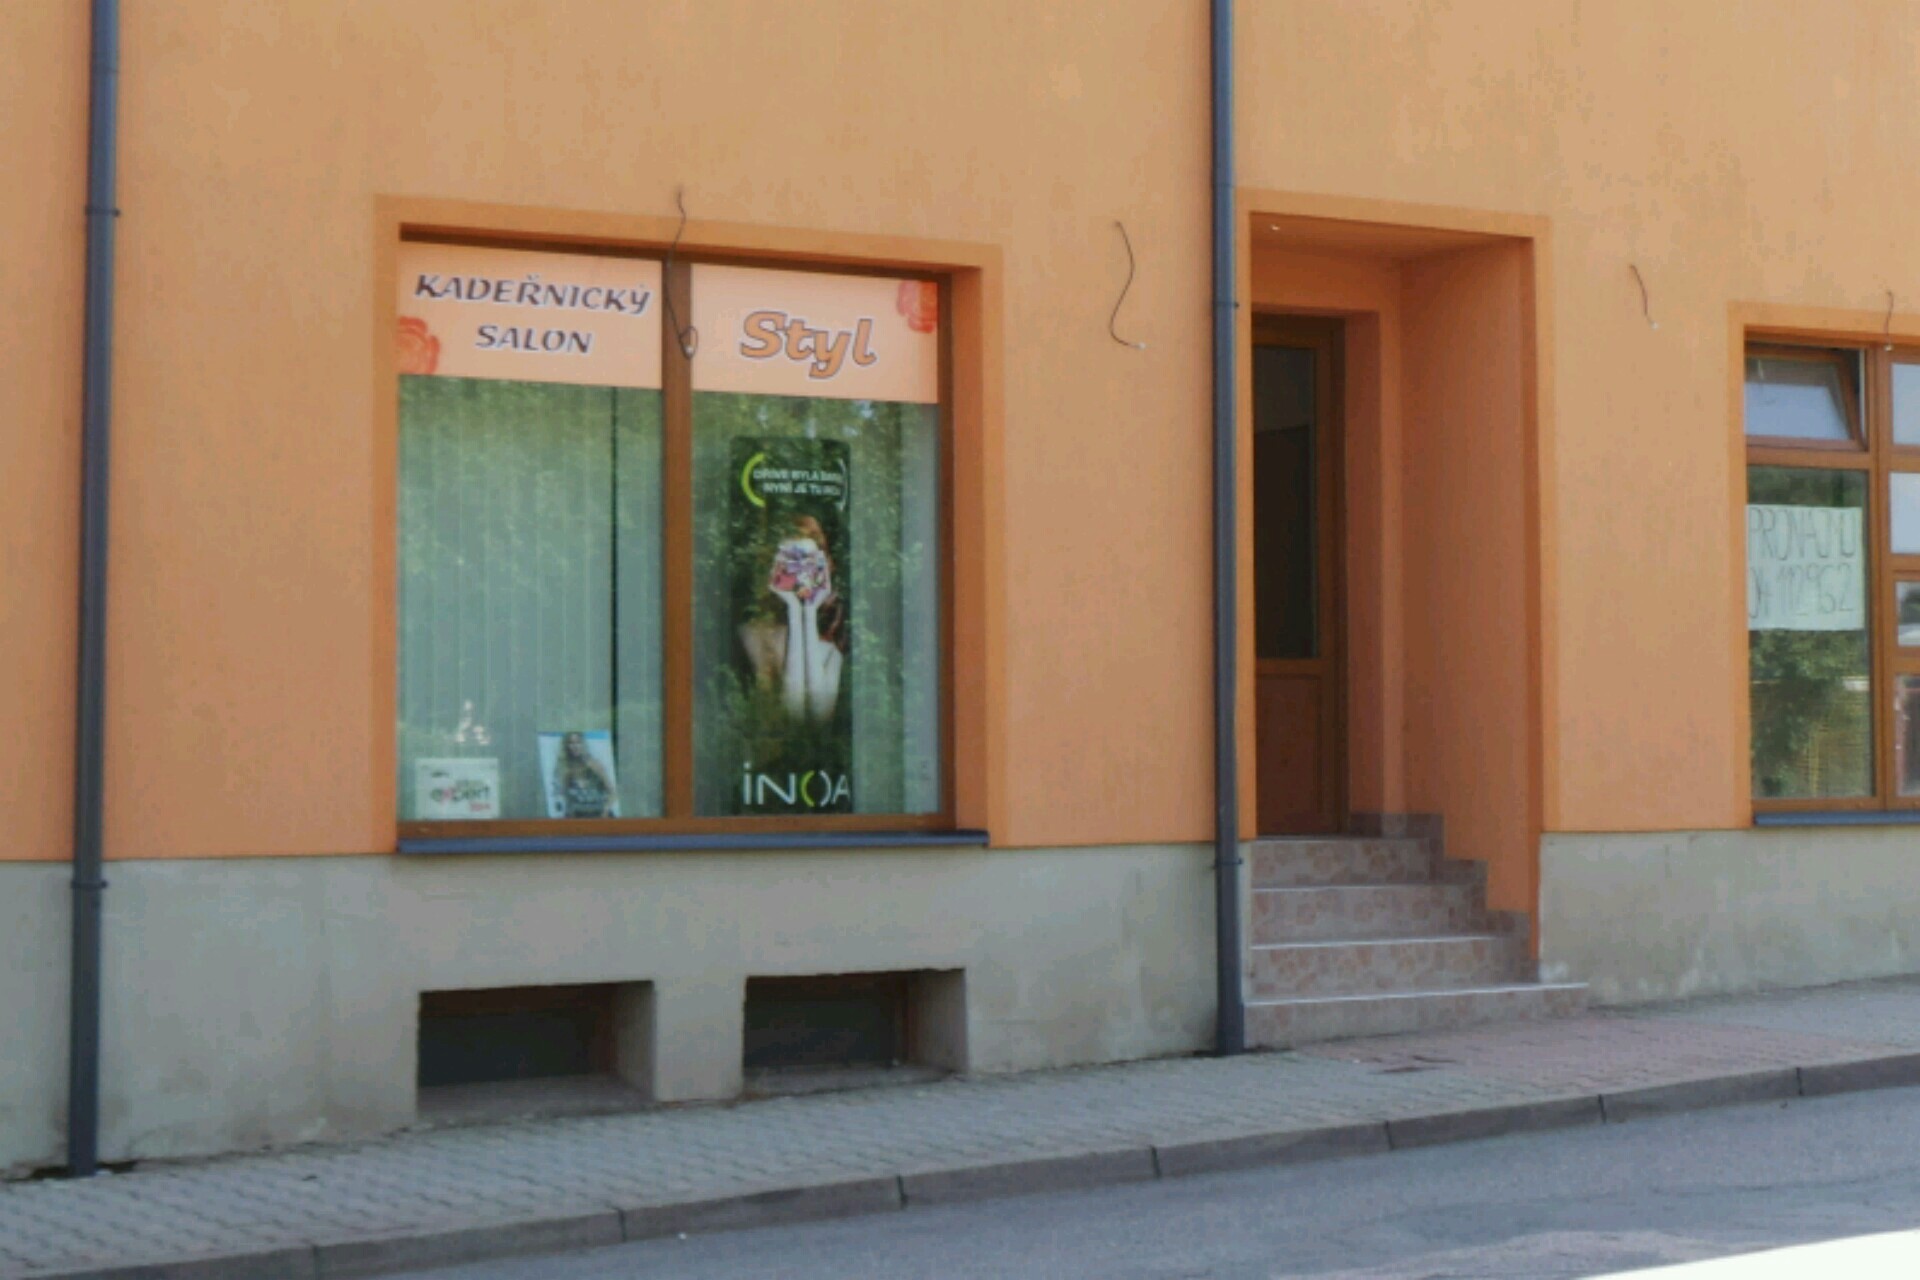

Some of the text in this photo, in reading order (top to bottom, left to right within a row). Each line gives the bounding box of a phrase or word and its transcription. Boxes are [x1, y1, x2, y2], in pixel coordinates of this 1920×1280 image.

[415, 273, 650, 315] KADEŘNICKÝ
[475, 322, 593, 354] SALON
[739, 310, 878, 380] Styl
